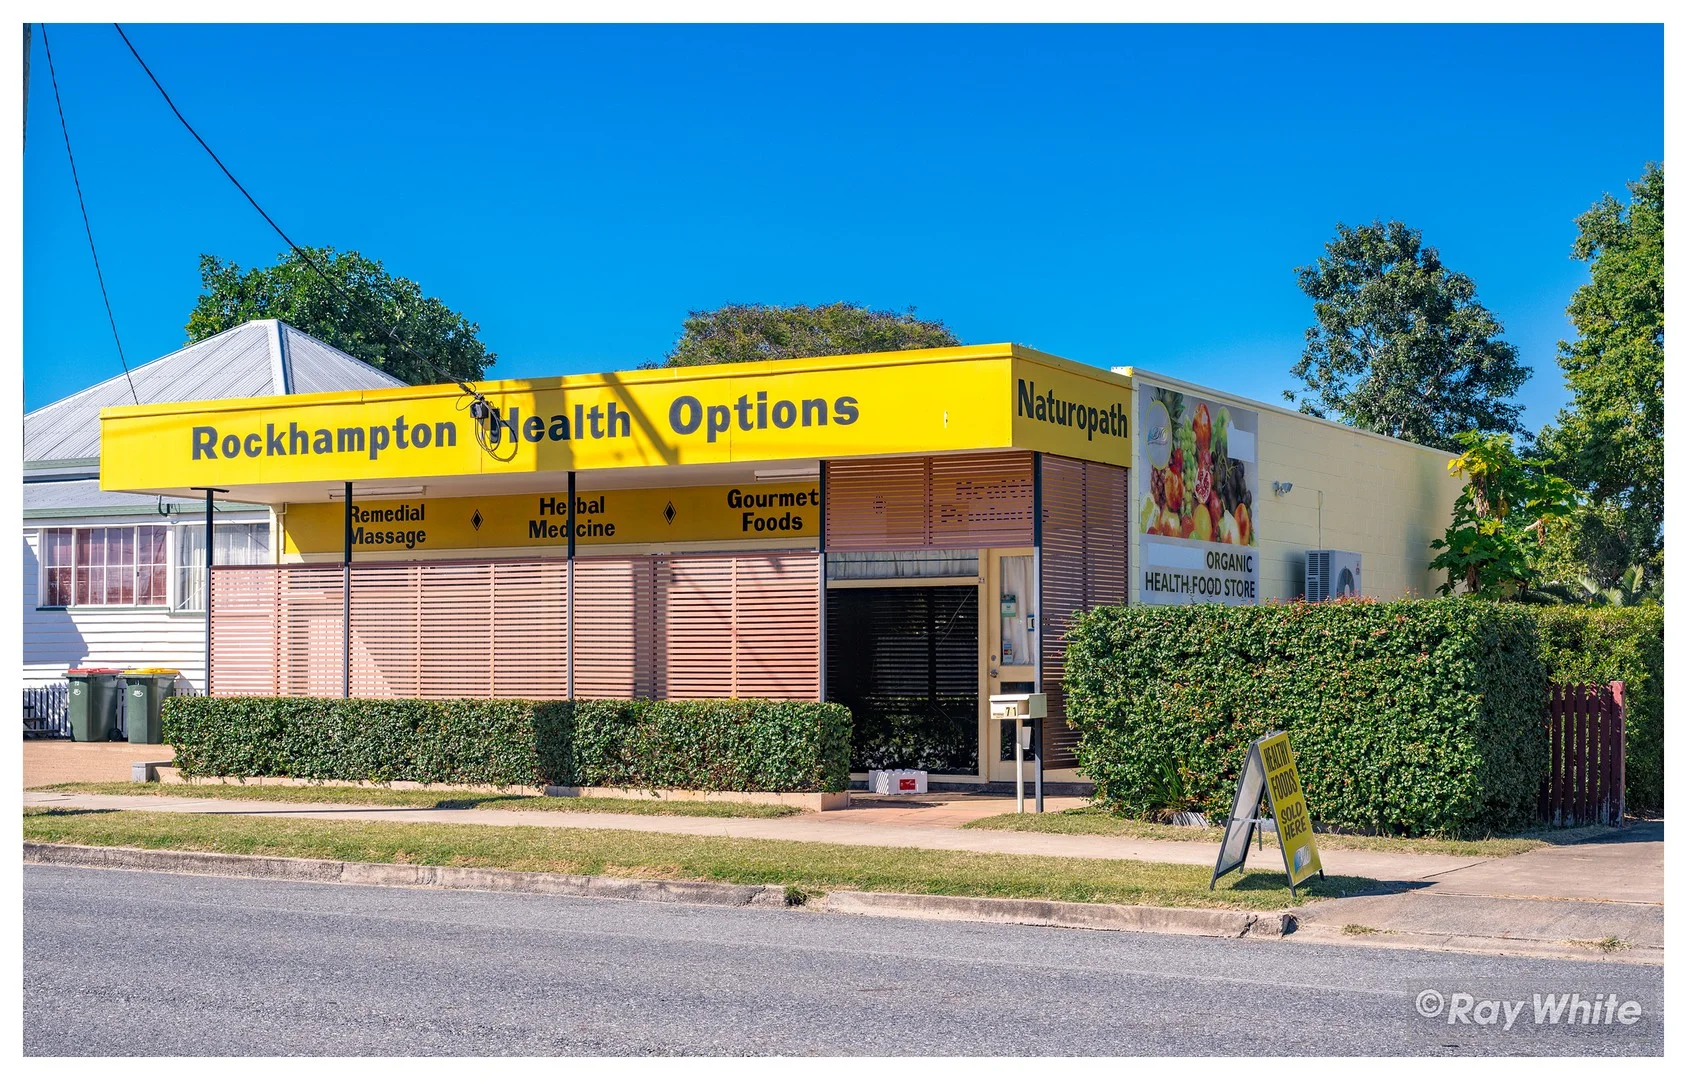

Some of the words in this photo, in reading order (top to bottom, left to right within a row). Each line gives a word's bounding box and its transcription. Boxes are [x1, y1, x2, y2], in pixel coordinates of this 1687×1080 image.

[1017, 378, 1128, 441] Naturopath
[192, 415, 456, 460] Rockhampton
[490, 402, 630, 444] Health
[669, 391, 859, 443] Options
[539, 495, 605, 515] Hebal
[727, 488, 819, 509] Gourmet
[350, 503, 425, 523] Remedial
[742, 511, 803, 532] Foods
[350, 526, 427, 549] Massage
[528, 519, 616, 539] Medcine
[1206, 550, 1253, 573] ORGANIC
[1145, 571, 1189, 594] HEALTH
[1192, 575, 1222, 596] FOOD
[1224, 578, 1256, 599] STORE
[1005, 706, 1017, 717] 71
[1263, 739, 1291, 773] HEALTHY
[1270, 767, 1298, 802] FOODS
[1280, 801, 1303, 825] SOLD
[1284, 815, 1307, 842] HERE
